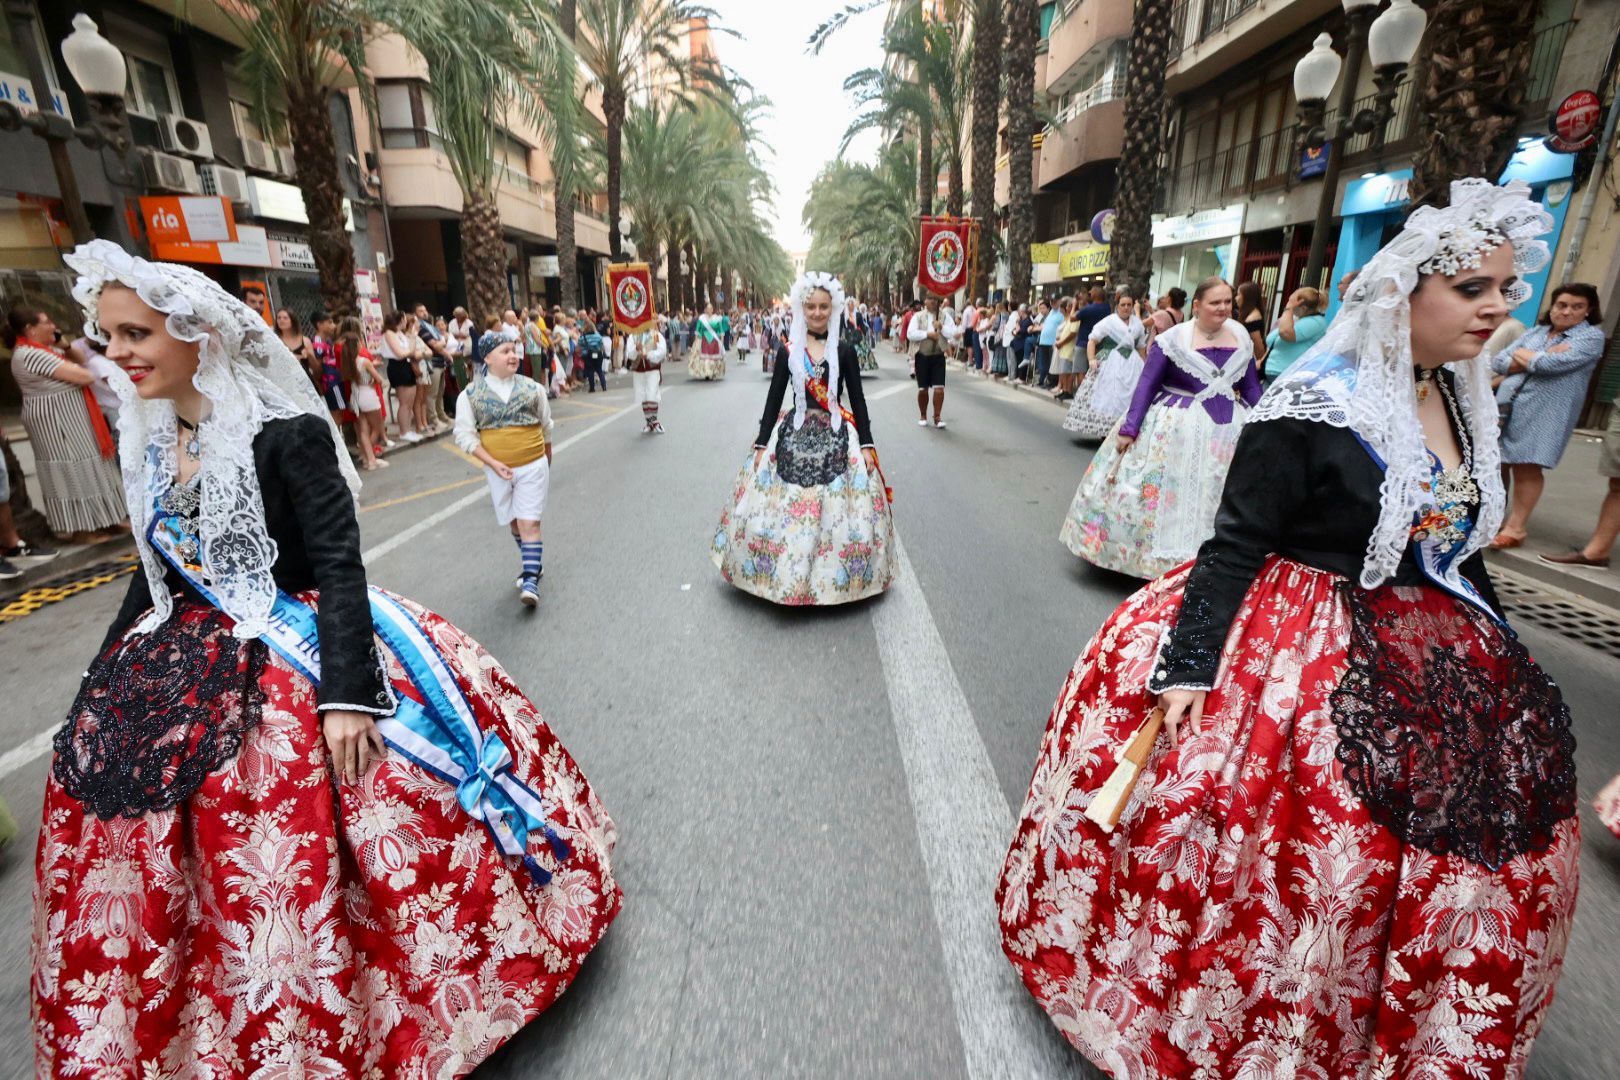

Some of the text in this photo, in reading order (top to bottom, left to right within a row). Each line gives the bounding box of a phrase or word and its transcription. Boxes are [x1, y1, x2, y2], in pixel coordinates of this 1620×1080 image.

[1564, 93, 1591, 110] Coca-Cola
[152, 207, 179, 229] ria
[267, 607, 321, 663] DE HO
